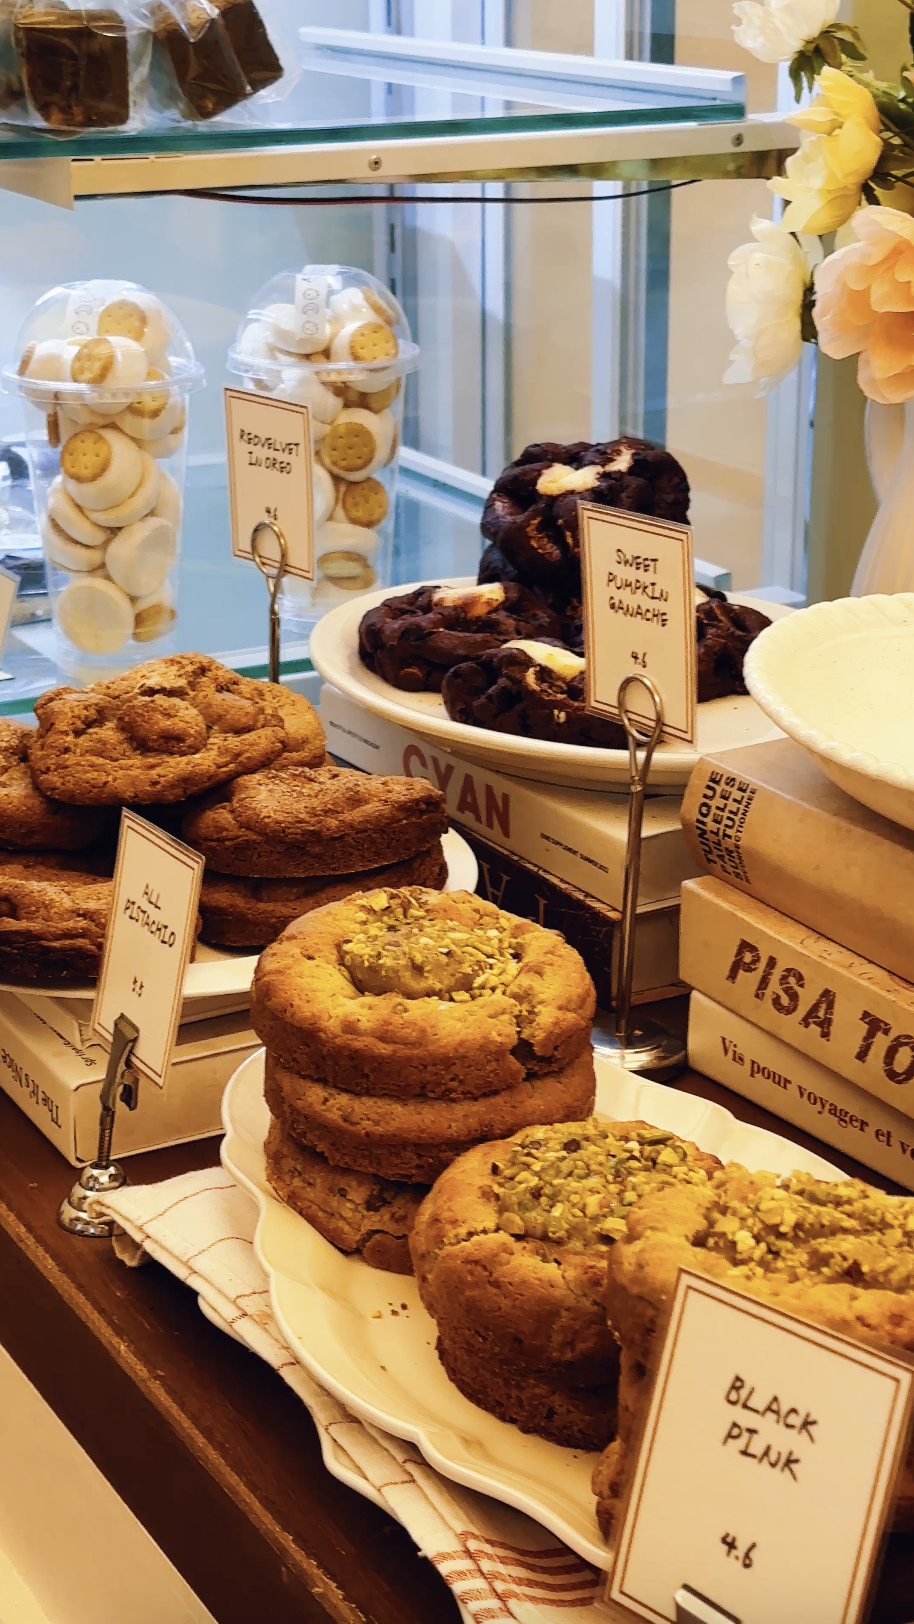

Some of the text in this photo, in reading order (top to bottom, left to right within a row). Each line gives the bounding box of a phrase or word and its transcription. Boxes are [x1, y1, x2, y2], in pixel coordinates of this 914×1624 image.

[239, 428, 300, 457] REDVELVET
[264, 456, 293, 475] OREO
[615, 548, 660, 575] SWEET
[606, 571, 670, 603] PUMPKIN
[608, 596, 669, 627] GANACHE
[695, 770, 724, 865] TUNIQUE
[722, 780, 750, 881] SUR TULLE
[141, 882, 162, 911] ALL
[123, 898, 177, 948] PISTACHIO
[725, 938, 914, 1085] PISA TO
[41, 1090, 62, 1129] The
[720, 1035, 746, 1066] Vis
[749, 1058, 792, 1090] pour
[797, 1084, 870, 1128] voyager
[874, 1128, 893, 1147] et
[724, 1373, 819, 1444] BLACK
[722, 1421, 801, 1482] PINK
[720, 1531, 758, 1569] 4.6
